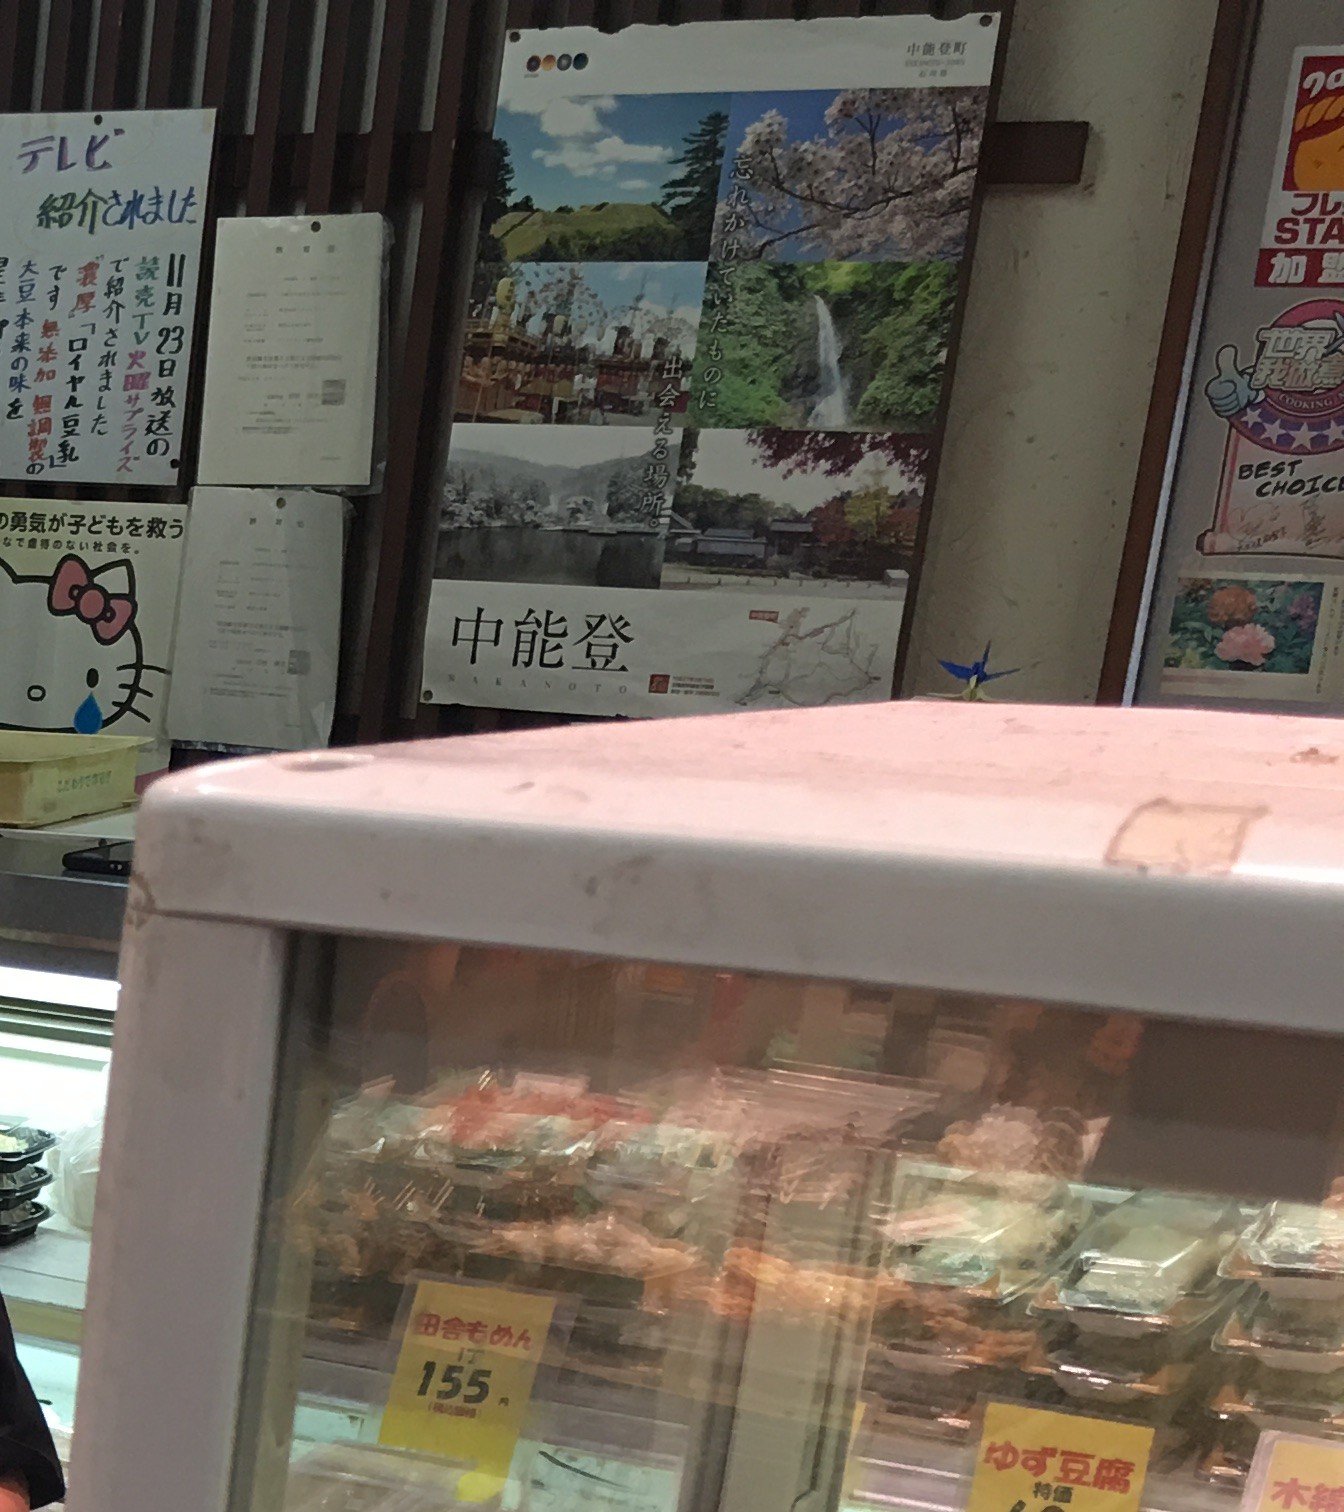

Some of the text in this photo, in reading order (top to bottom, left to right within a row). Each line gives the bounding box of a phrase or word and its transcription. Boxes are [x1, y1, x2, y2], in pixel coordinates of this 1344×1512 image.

[17, 128, 125, 174] テレビ
[36, 186, 197, 234] 紹介されました
[698, 155, 754, 410] 忘れかけていたものに
[90, 257, 129, 436] で紹介されました
[1238, 459, 1302, 480] BEST
[451, 606, 635, 673] 中能登
[416, 1361, 492, 1404] 155
[983, 1440, 1136, 1495] ゆず豆腐
[1033, 1482, 1074, 1504] 特価
